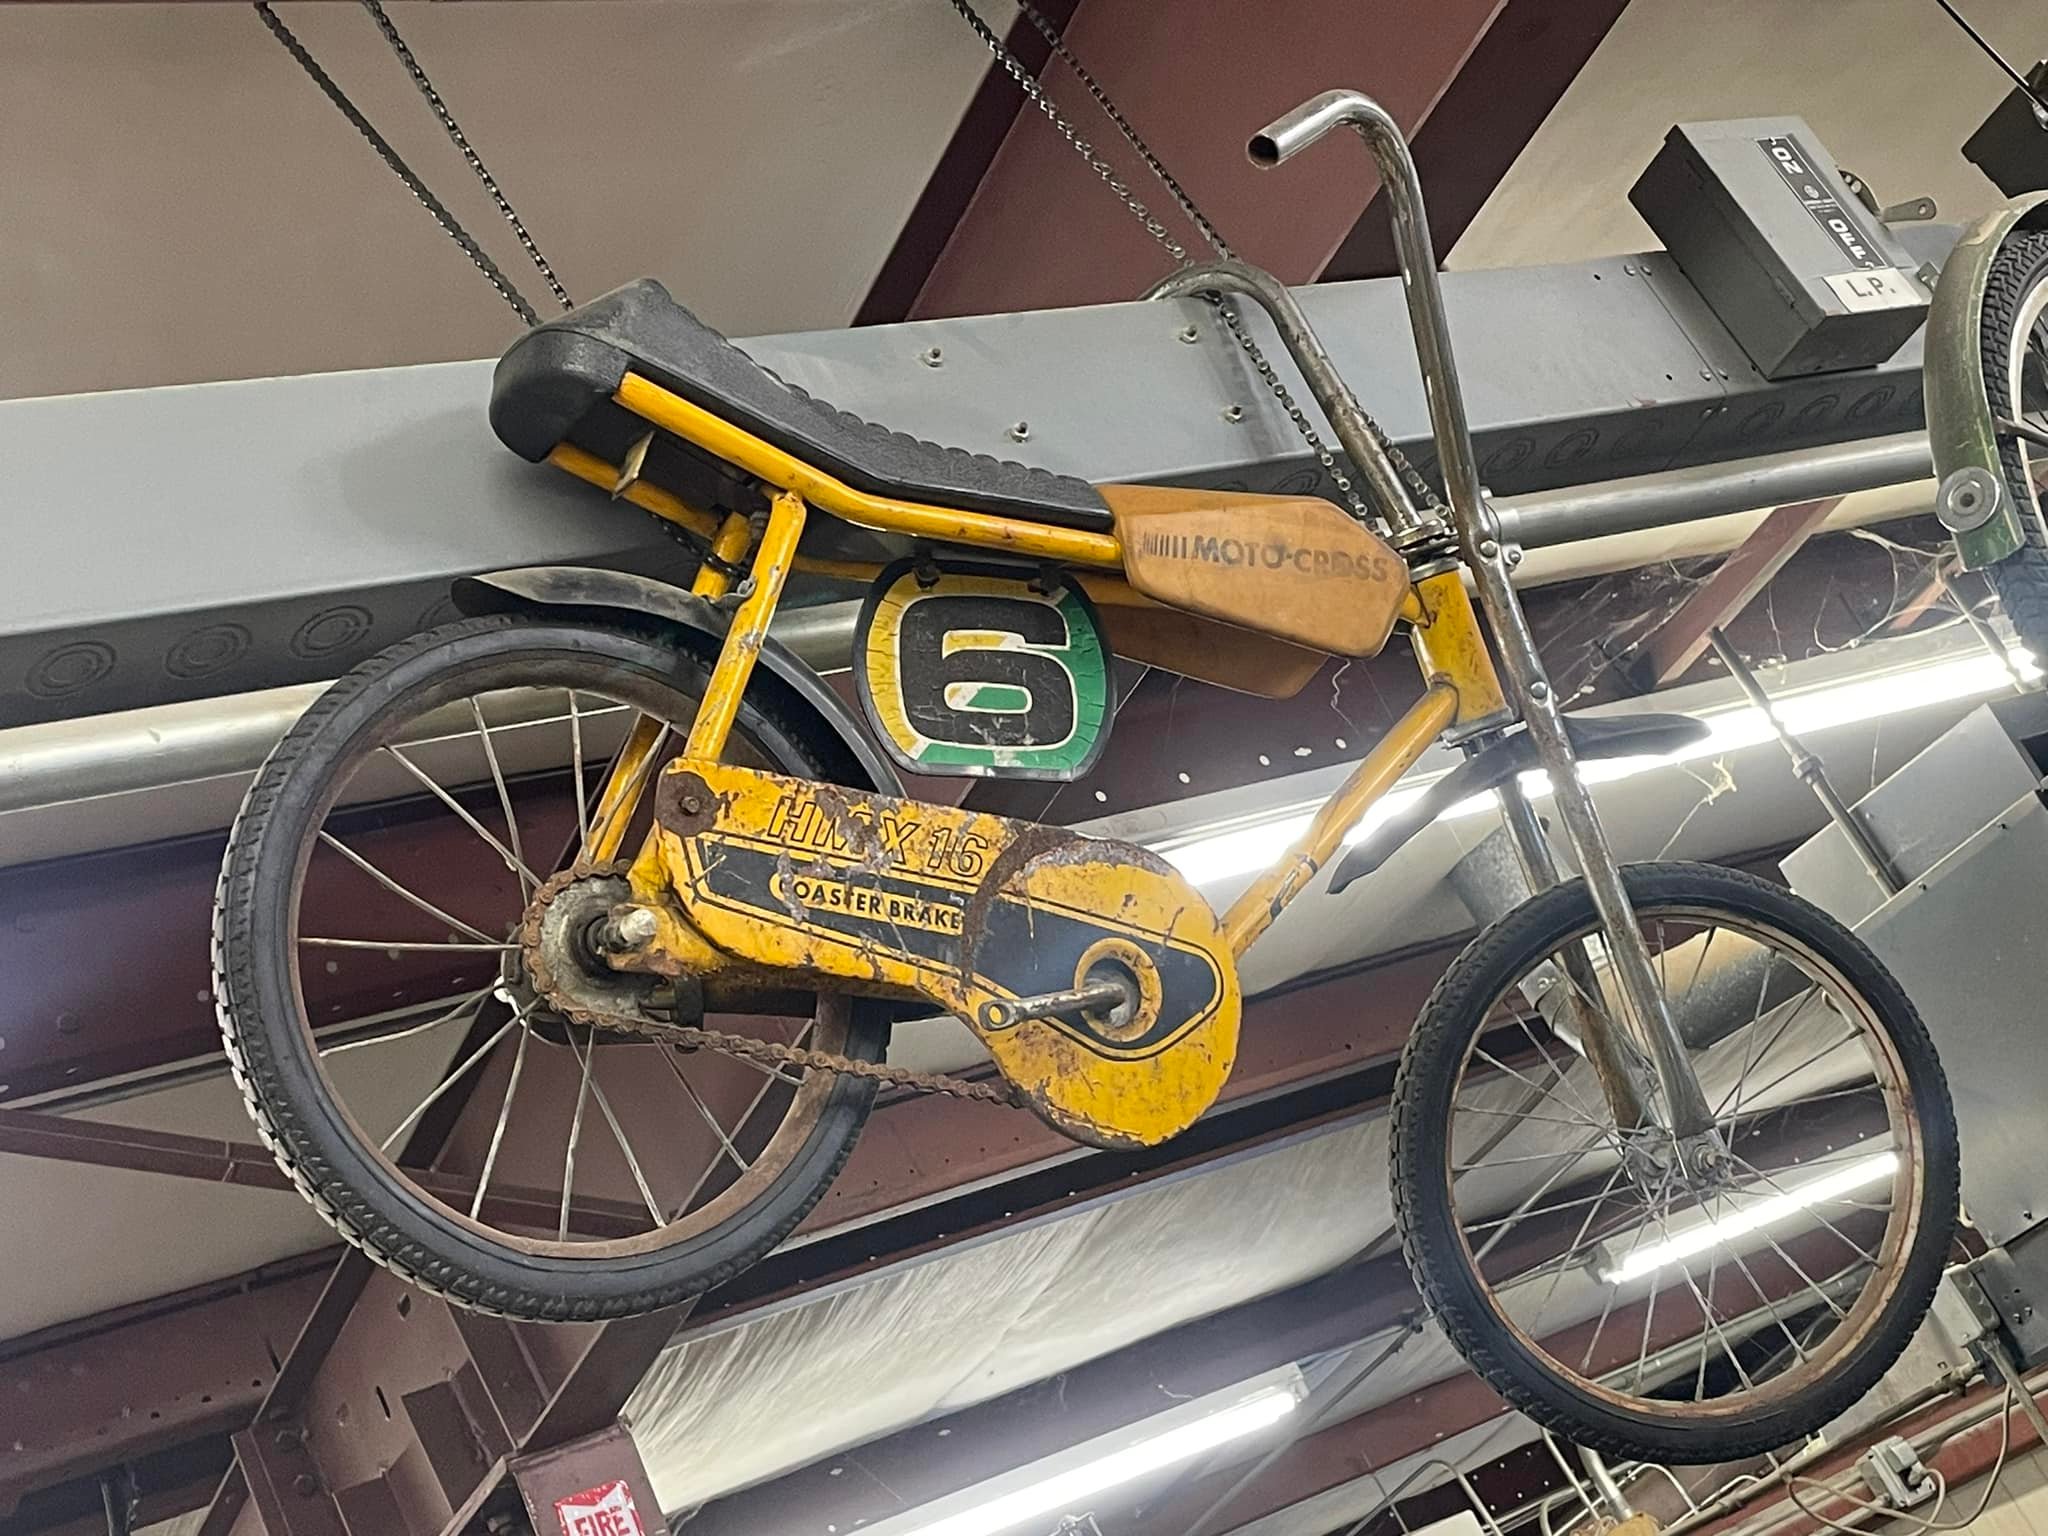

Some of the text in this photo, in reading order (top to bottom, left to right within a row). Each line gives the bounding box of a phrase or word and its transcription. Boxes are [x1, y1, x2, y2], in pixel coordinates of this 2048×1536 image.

[1771, 147, 1804, 175] ON
[1827, 218, 1867, 260] OFF
[897, 595, 1079, 750] 6
[927, 827, 989, 879] 16
[889, 900, 963, 931] BRAKE
[573, 1505, 630, 1536] FIRE
